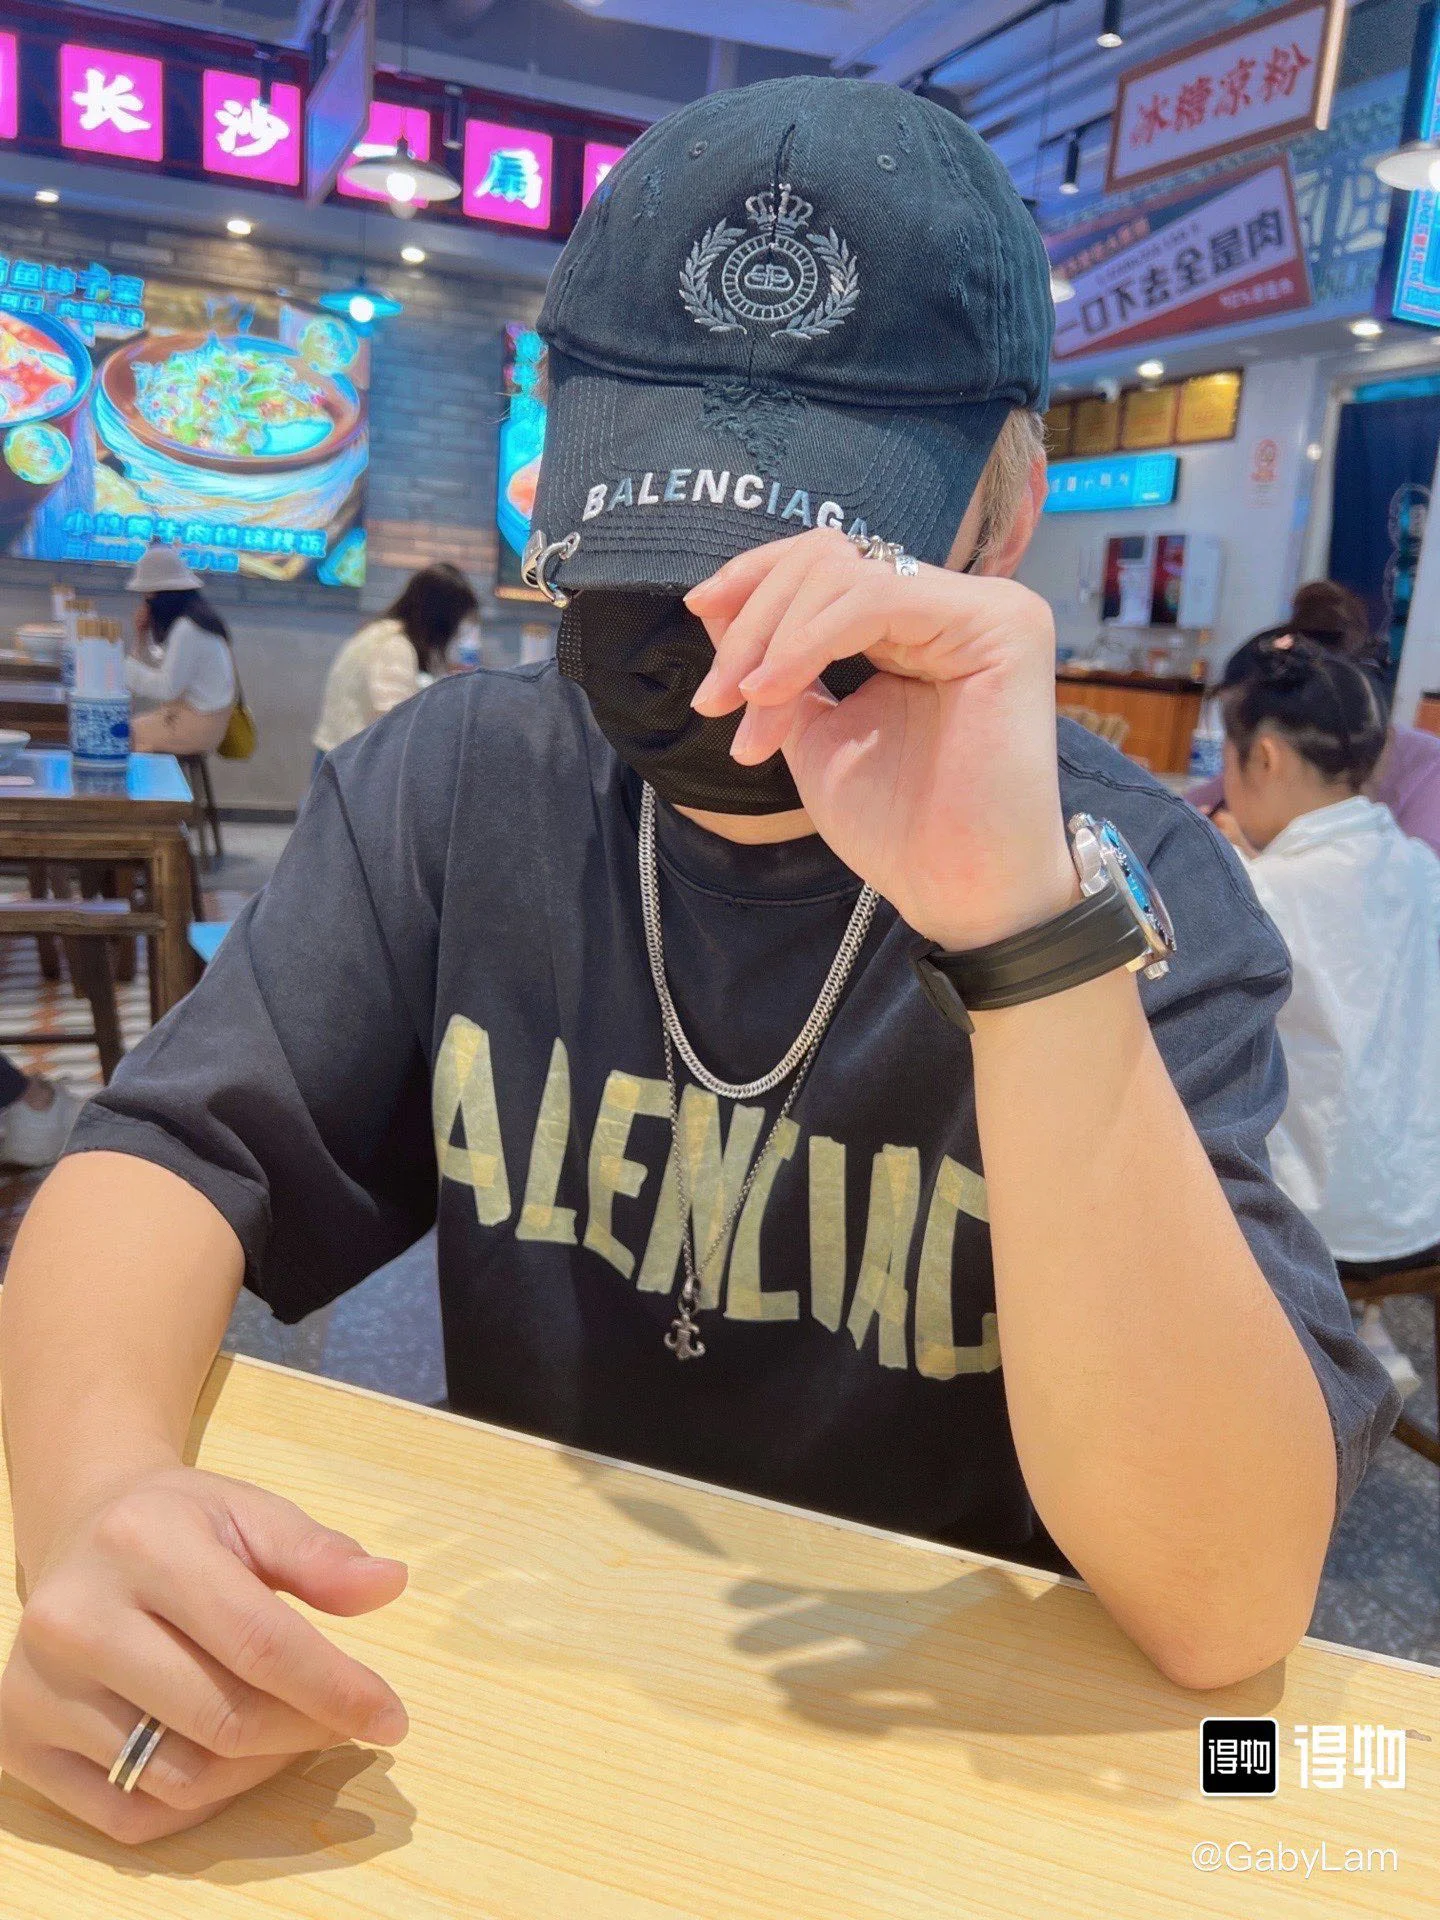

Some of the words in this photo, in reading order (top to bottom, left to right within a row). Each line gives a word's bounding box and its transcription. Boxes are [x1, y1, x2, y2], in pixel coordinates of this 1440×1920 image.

[1057, 208, 1283, 336] 一口下去全是肉
